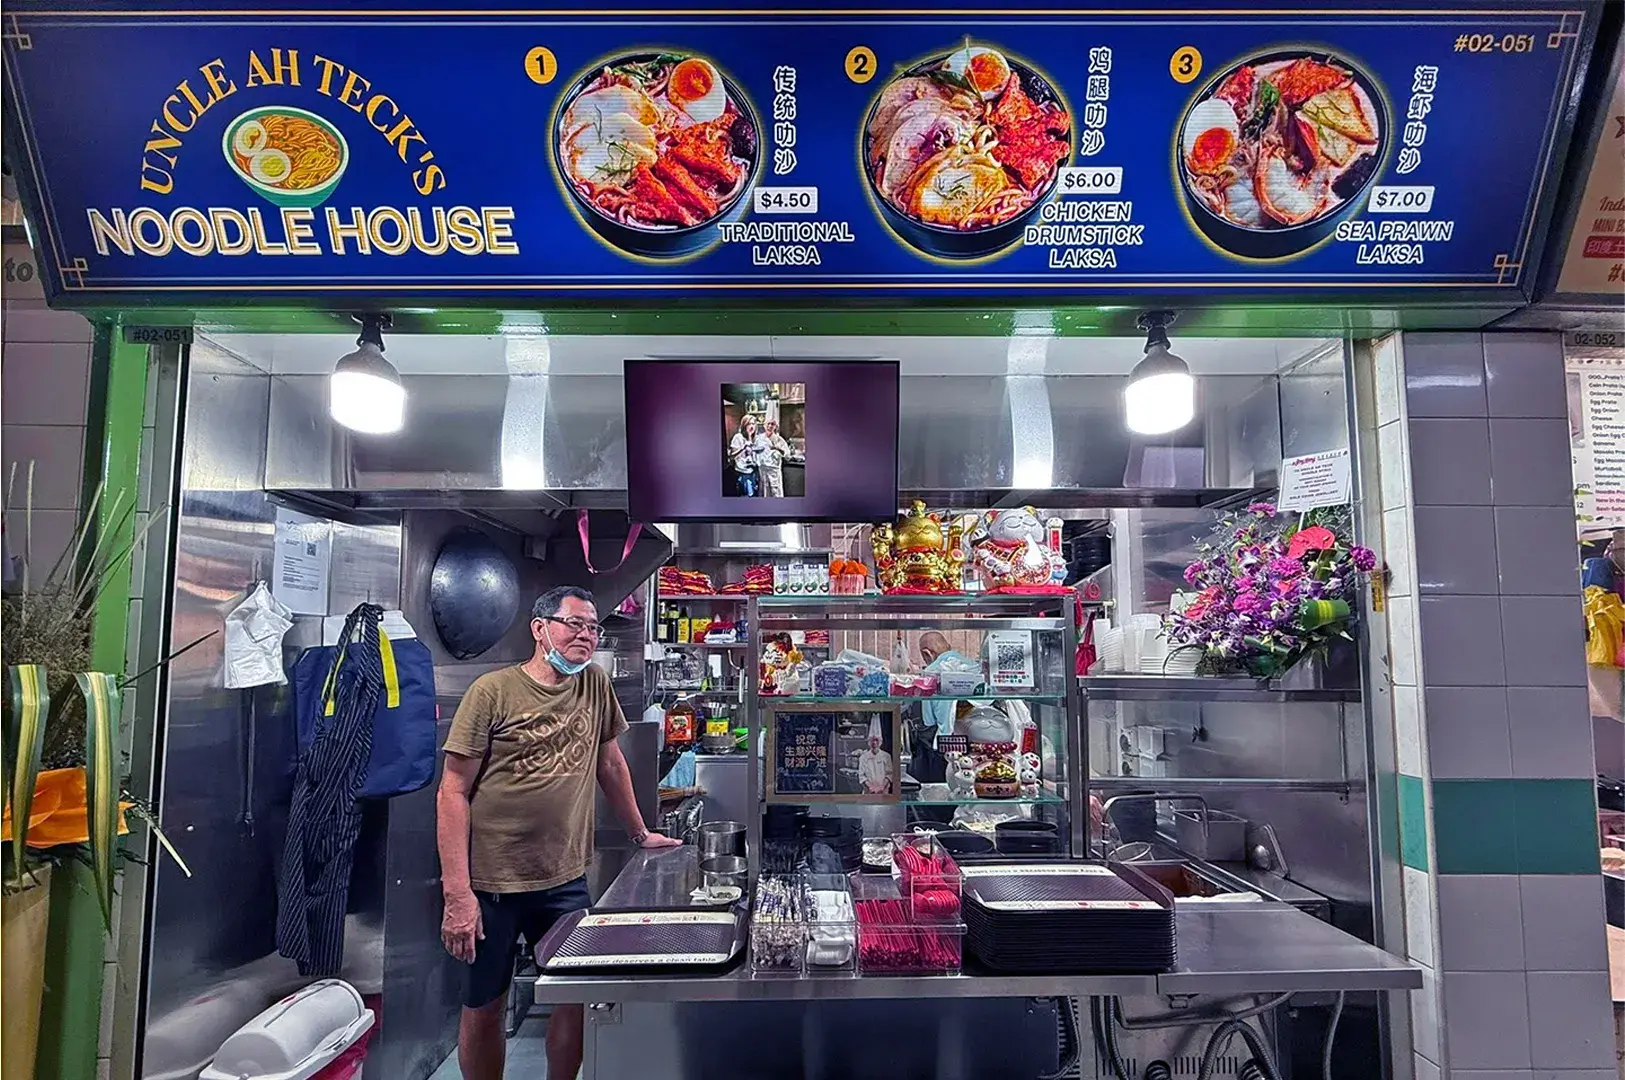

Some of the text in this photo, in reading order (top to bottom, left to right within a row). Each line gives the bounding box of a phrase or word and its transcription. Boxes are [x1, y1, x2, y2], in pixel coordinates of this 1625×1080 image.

[1454, 34, 1535, 52] #02-051
[535, 54, 546, 75] 1
[853, 53, 869, 75] 2
[1178, 52, 1194, 75] 3
[1080, 46, 1112, 156] 鸡腿叻沙
[140, 47, 447, 197] UNCLE AH TECK'S
[773, 65, 797, 175] 传统叻沙
[1396, 65, 1439, 174] 海虾叻沙
[1063, 172, 1116, 188] $6.00
[760, 190, 811, 208] $4.50
[1375, 190, 1428, 207] $7.00
[1040, 201, 1132, 223] CHICKEN
[86, 206, 520, 257] NOODLE HOUSE
[717, 222, 854, 242] TRADITIONAL
[1024, 225, 1144, 245] DRUMSTICK
[1336, 220, 1454, 241] SEA PRAWN
[1615, 218, 1625, 233] B
[752, 246, 821, 265] LAKSA
[1049, 249, 1117, 269] LAKSA
[1356, 245, 1424, 265] LAKSA
[133, 329, 188, 342] #02-051
[1574, 333, 1616, 345] 02-052
